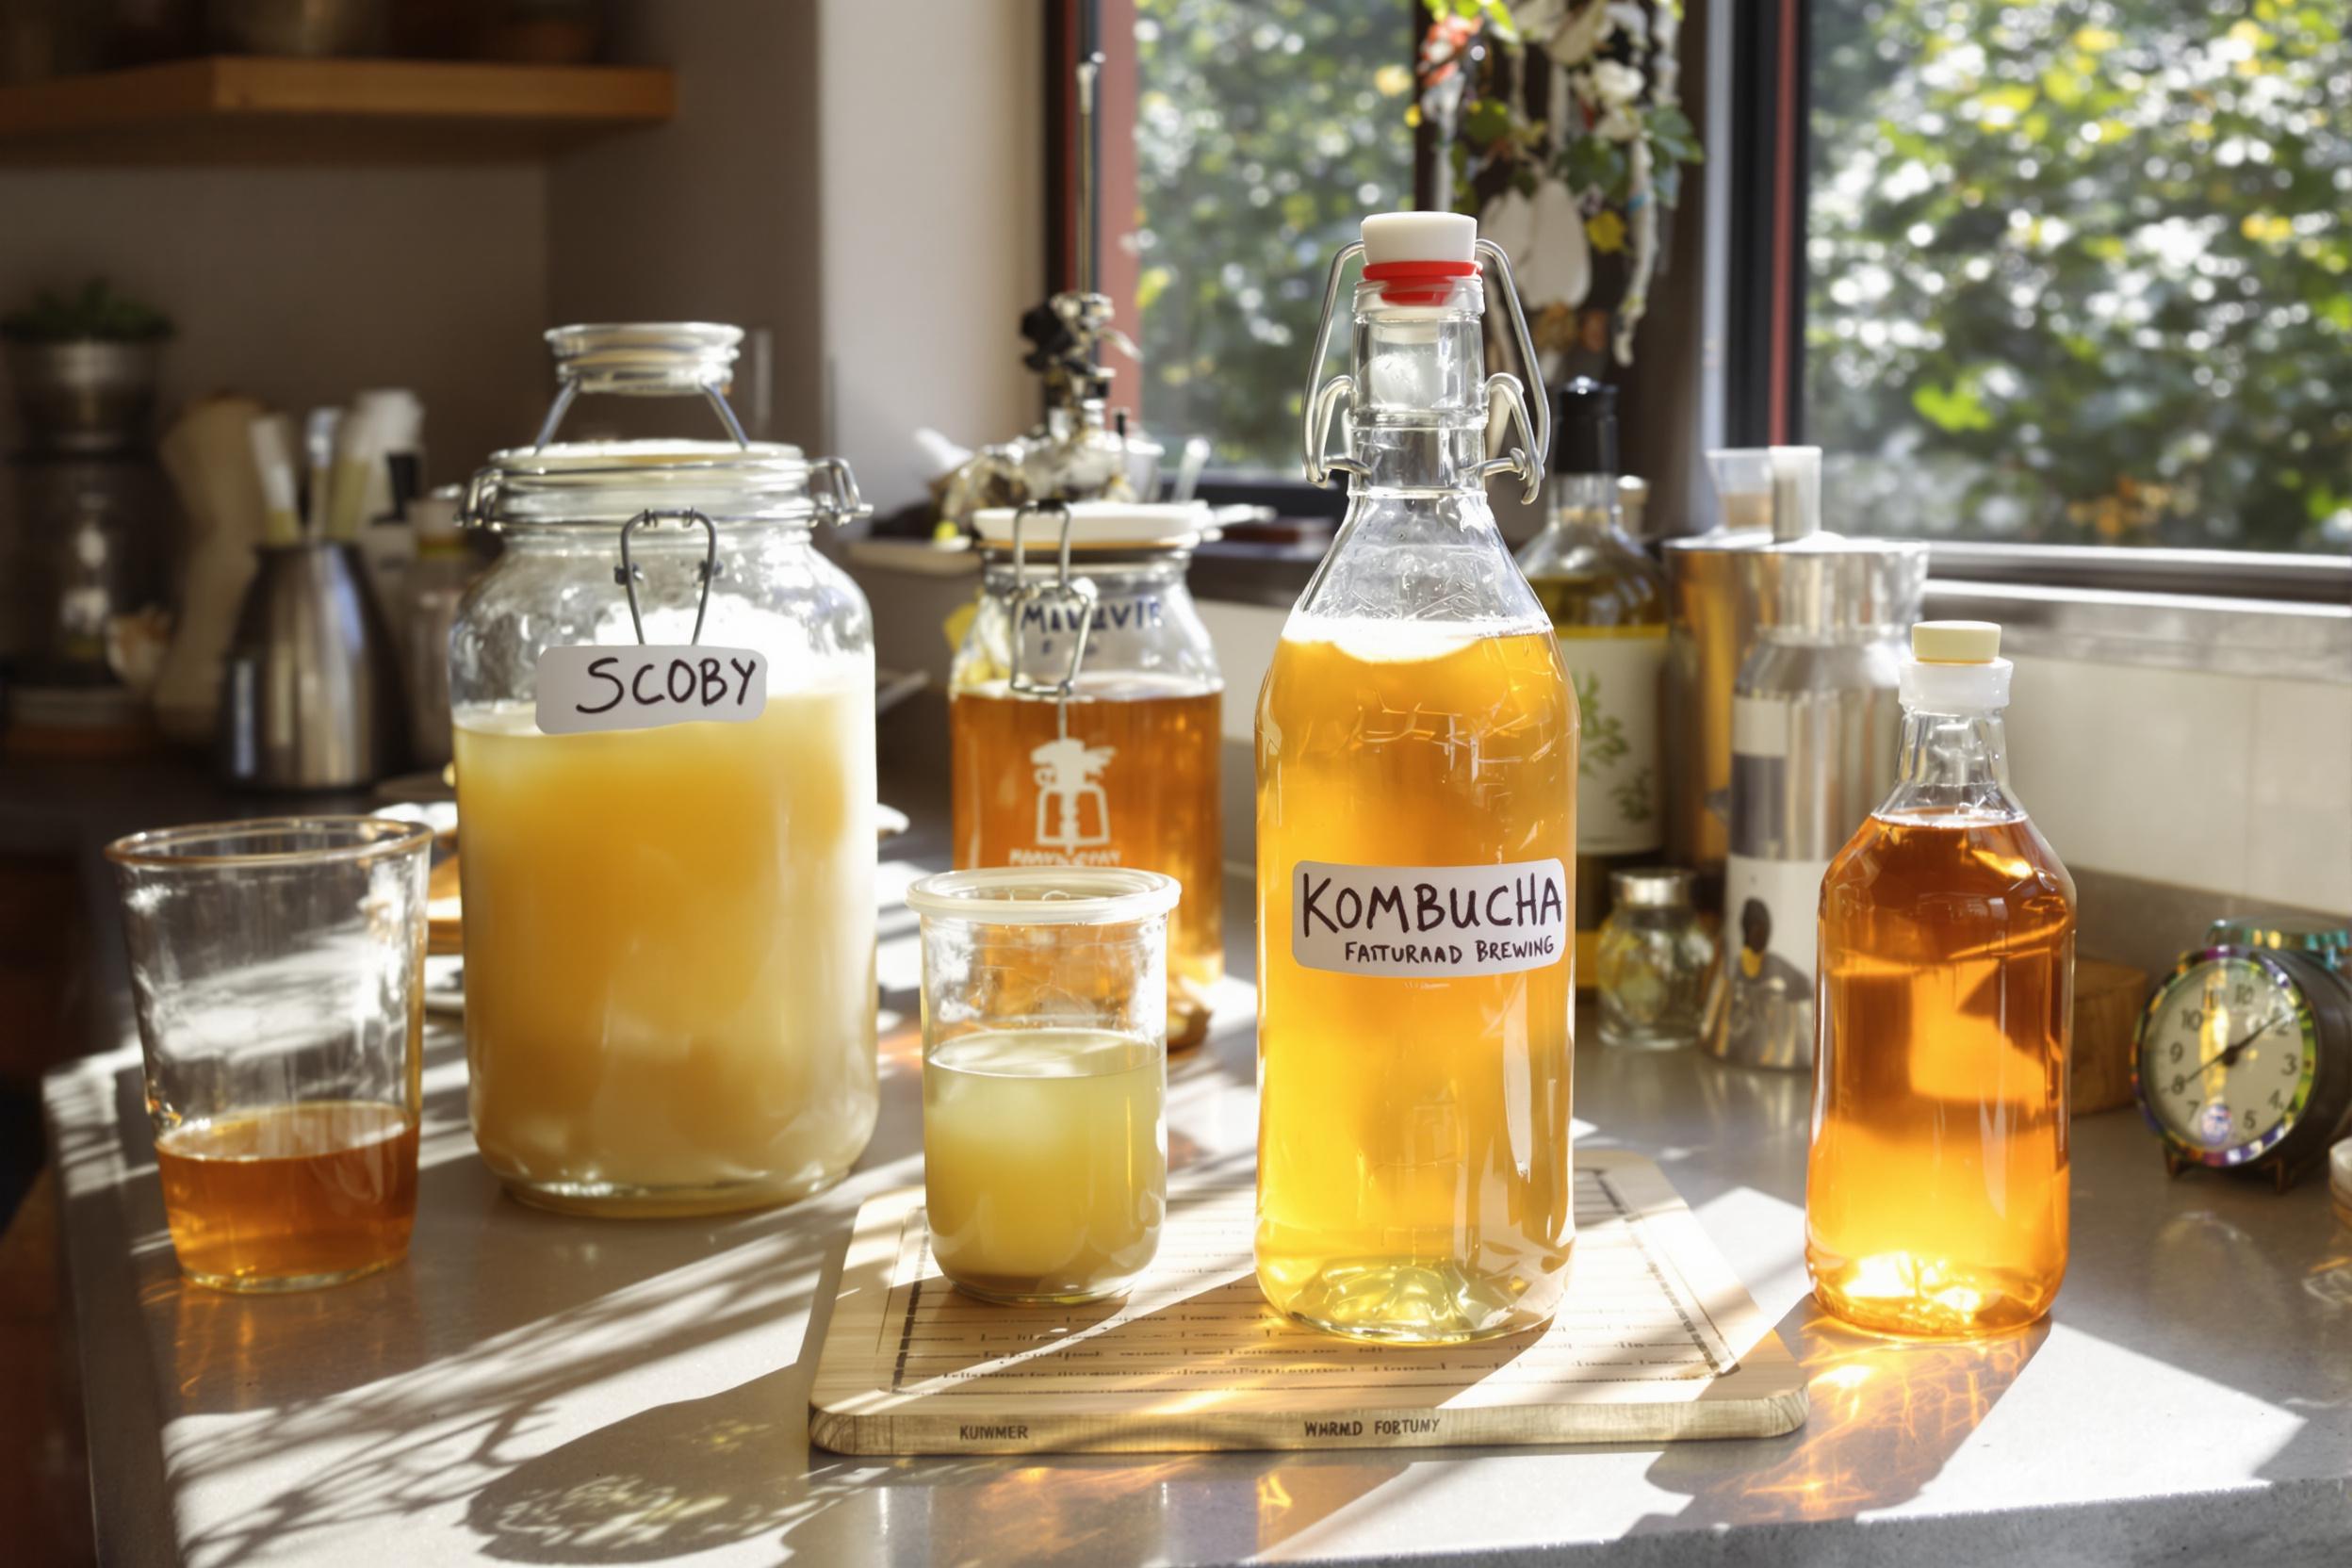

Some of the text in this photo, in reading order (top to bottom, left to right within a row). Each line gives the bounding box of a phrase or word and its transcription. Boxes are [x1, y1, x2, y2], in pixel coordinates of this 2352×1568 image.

[576, 657, 757, 714] SCOBY
[1301, 873, 1562, 939] KOMBUCHA
[1476, 936, 1555, 963] BREWING
[2169, 1042, 2184, 1065] 9
[2281, 1054, 2297, 1076] 3
[2170, 1074, 2186, 1096] 8
[2186, 1101, 2200, 1120] 7
[2244, 1109, 2258, 1130] 5
